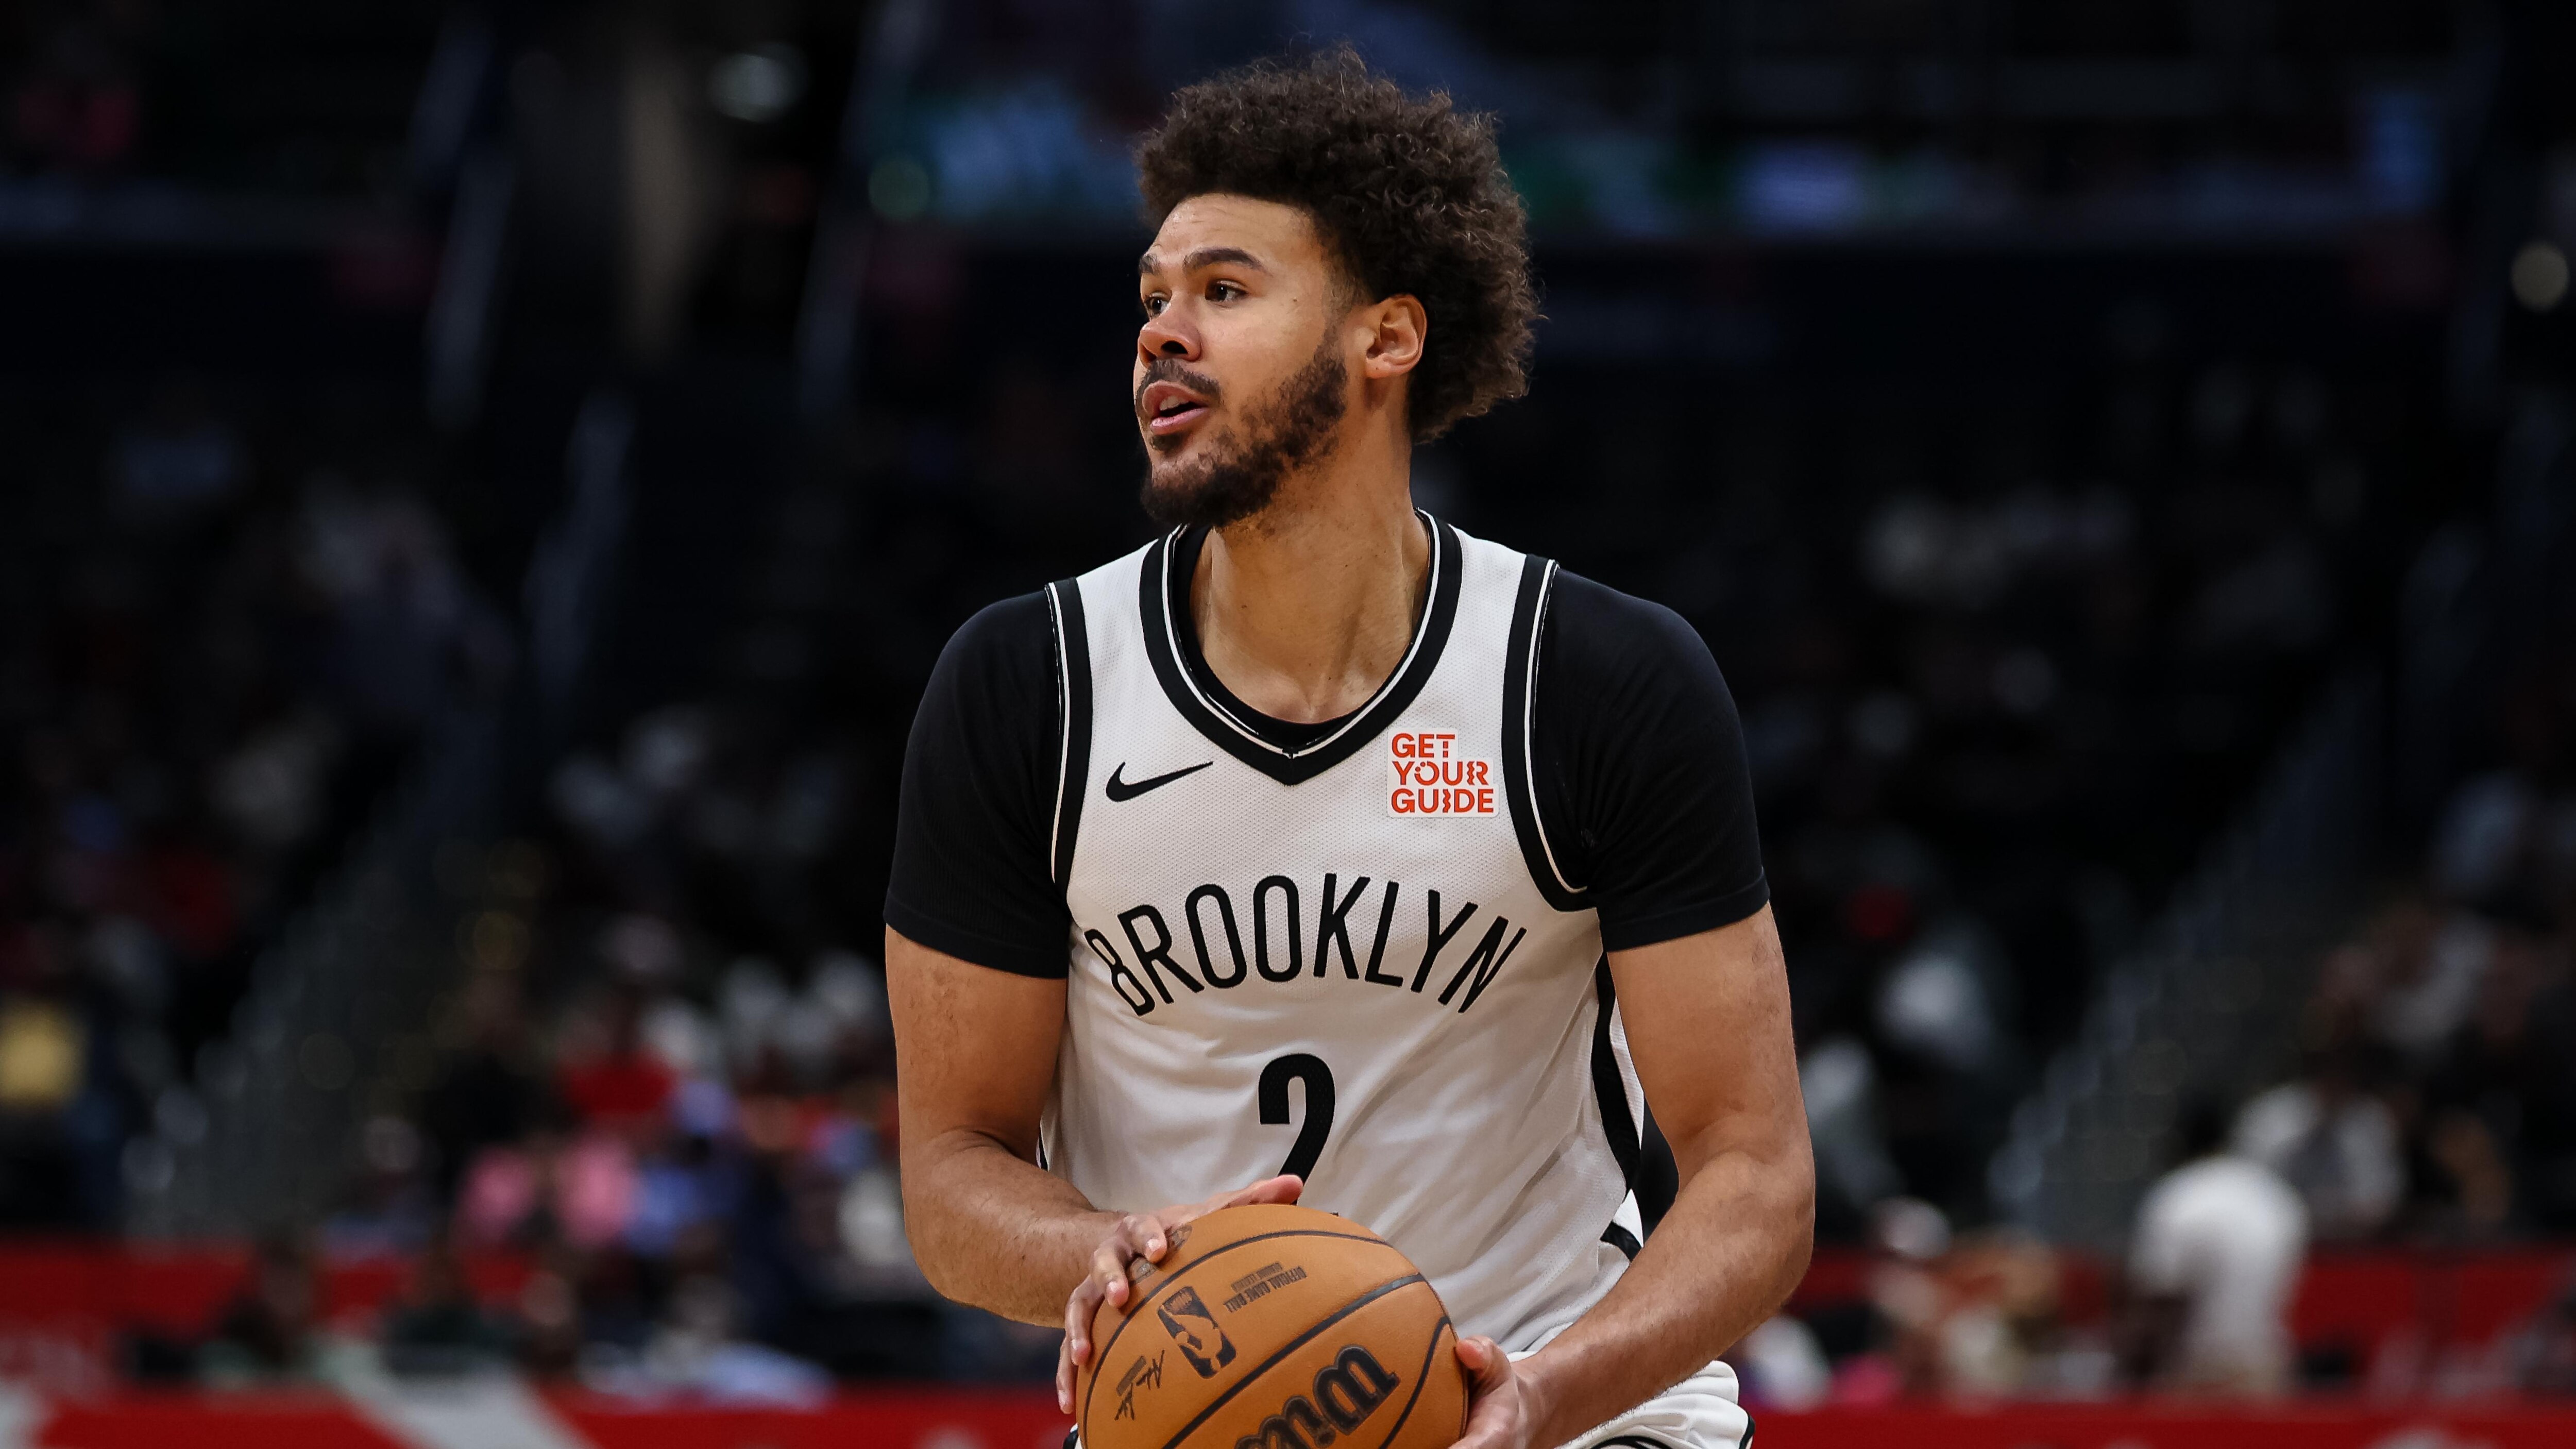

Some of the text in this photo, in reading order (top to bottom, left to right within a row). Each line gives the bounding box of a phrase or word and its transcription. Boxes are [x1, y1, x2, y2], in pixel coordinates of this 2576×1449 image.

[1391, 733, 1455, 759] GET
[1392, 761, 1488, 786] YOUR
[1391, 788, 1494, 814] GUIDE
[1084, 873, 1527, 1016] BROOKLYN
[1258, 1053, 1337, 1211] 2
